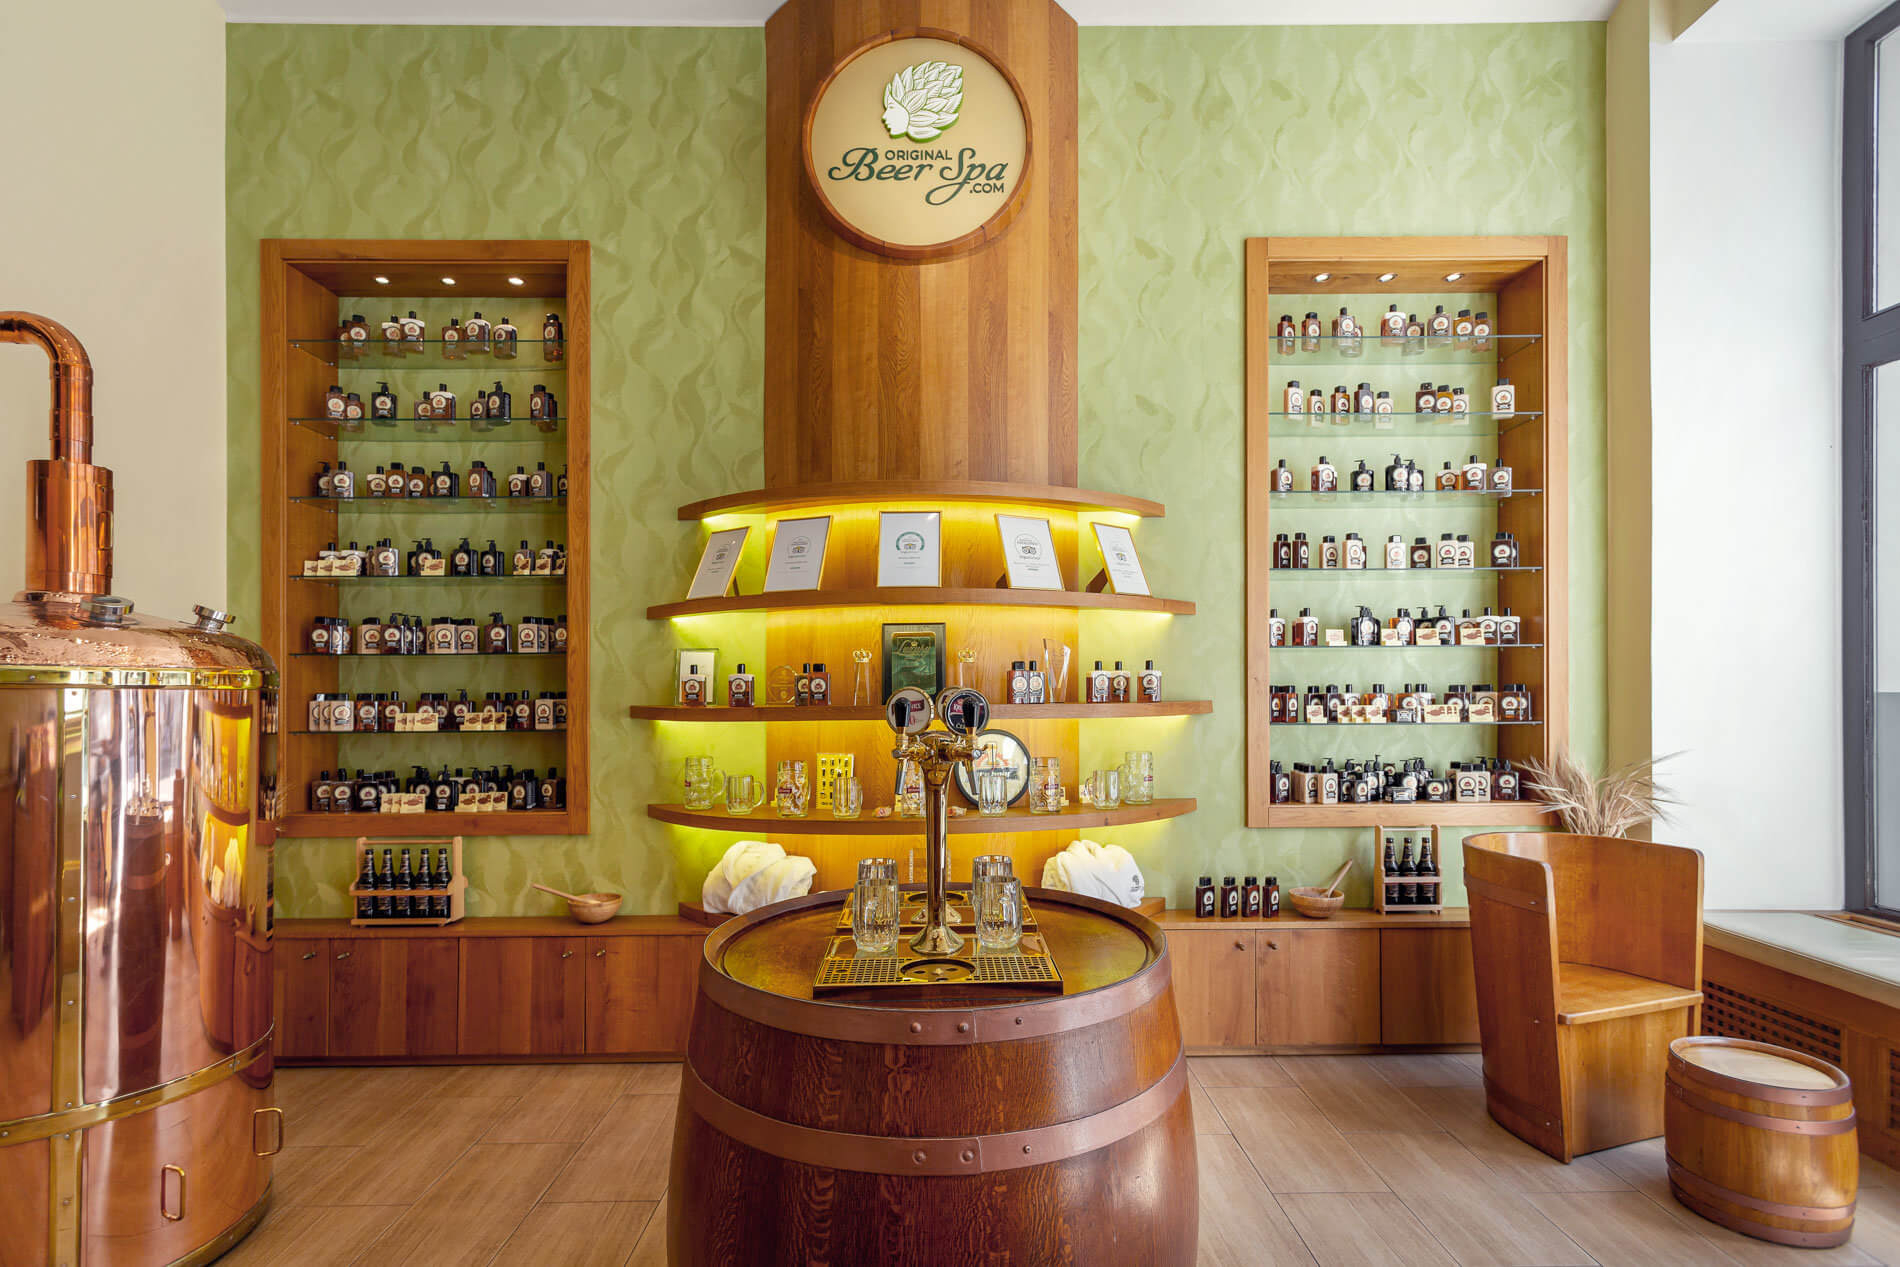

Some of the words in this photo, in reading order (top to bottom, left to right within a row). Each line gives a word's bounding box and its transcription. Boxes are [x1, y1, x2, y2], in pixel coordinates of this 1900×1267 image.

[885, 150, 952, 160] ORIGINAL
[828, 147, 934, 181] Beer
[925, 147, 1008, 206] Spa
[969, 183, 1005, 194] .COM
